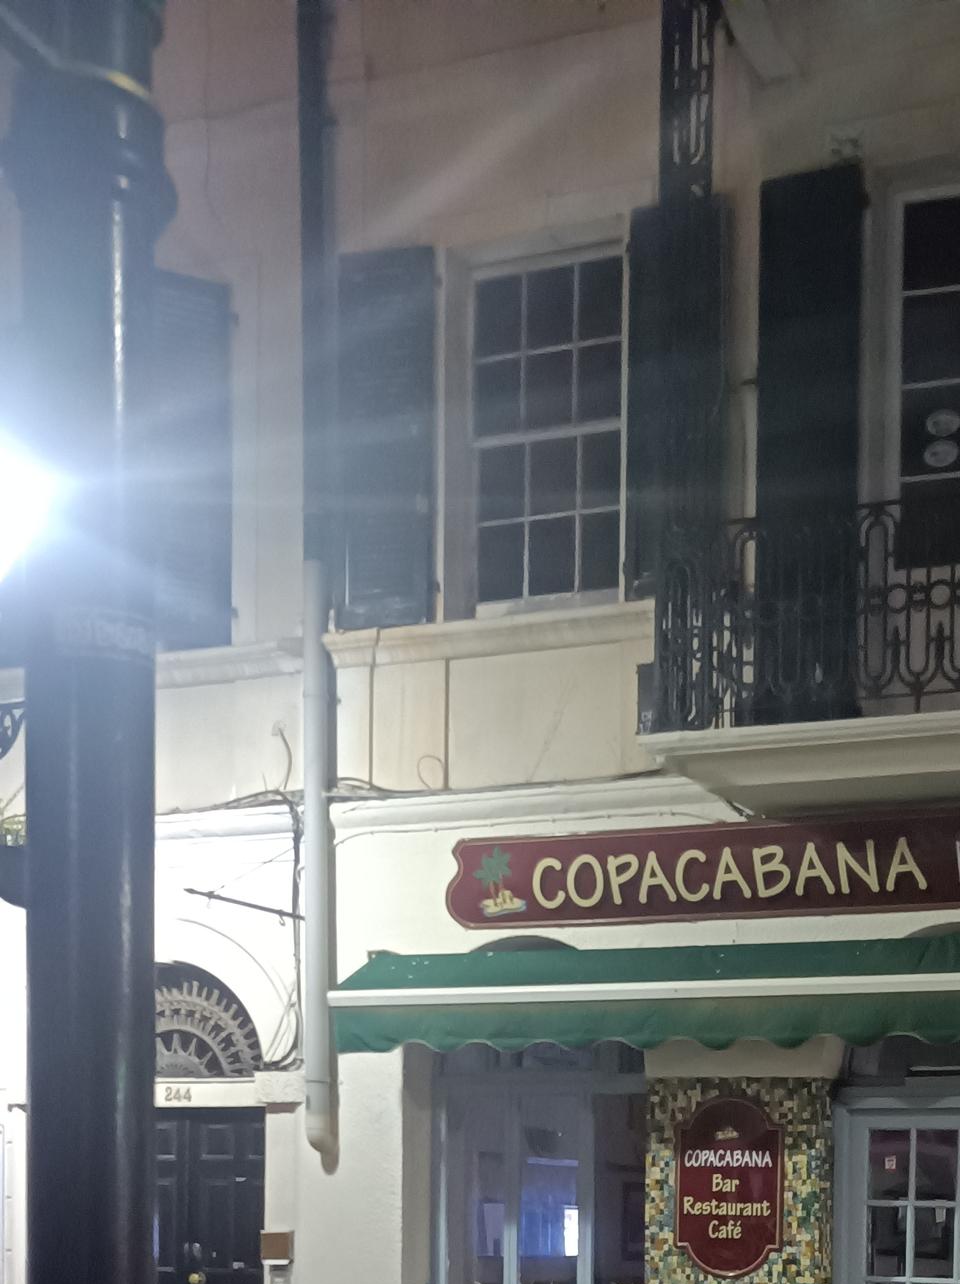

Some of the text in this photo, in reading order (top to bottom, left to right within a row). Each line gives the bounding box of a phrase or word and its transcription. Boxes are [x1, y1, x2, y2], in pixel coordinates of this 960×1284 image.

[532, 836, 928, 908] COPACABANA
[165, 1086, 193, 1102] 244
[685, 1150, 773, 1167] COPACABANA
[712, 1174, 740, 1192] Bar
[683, 1196, 771, 1216] Restaurant
[708, 1220, 742, 1239] Café
